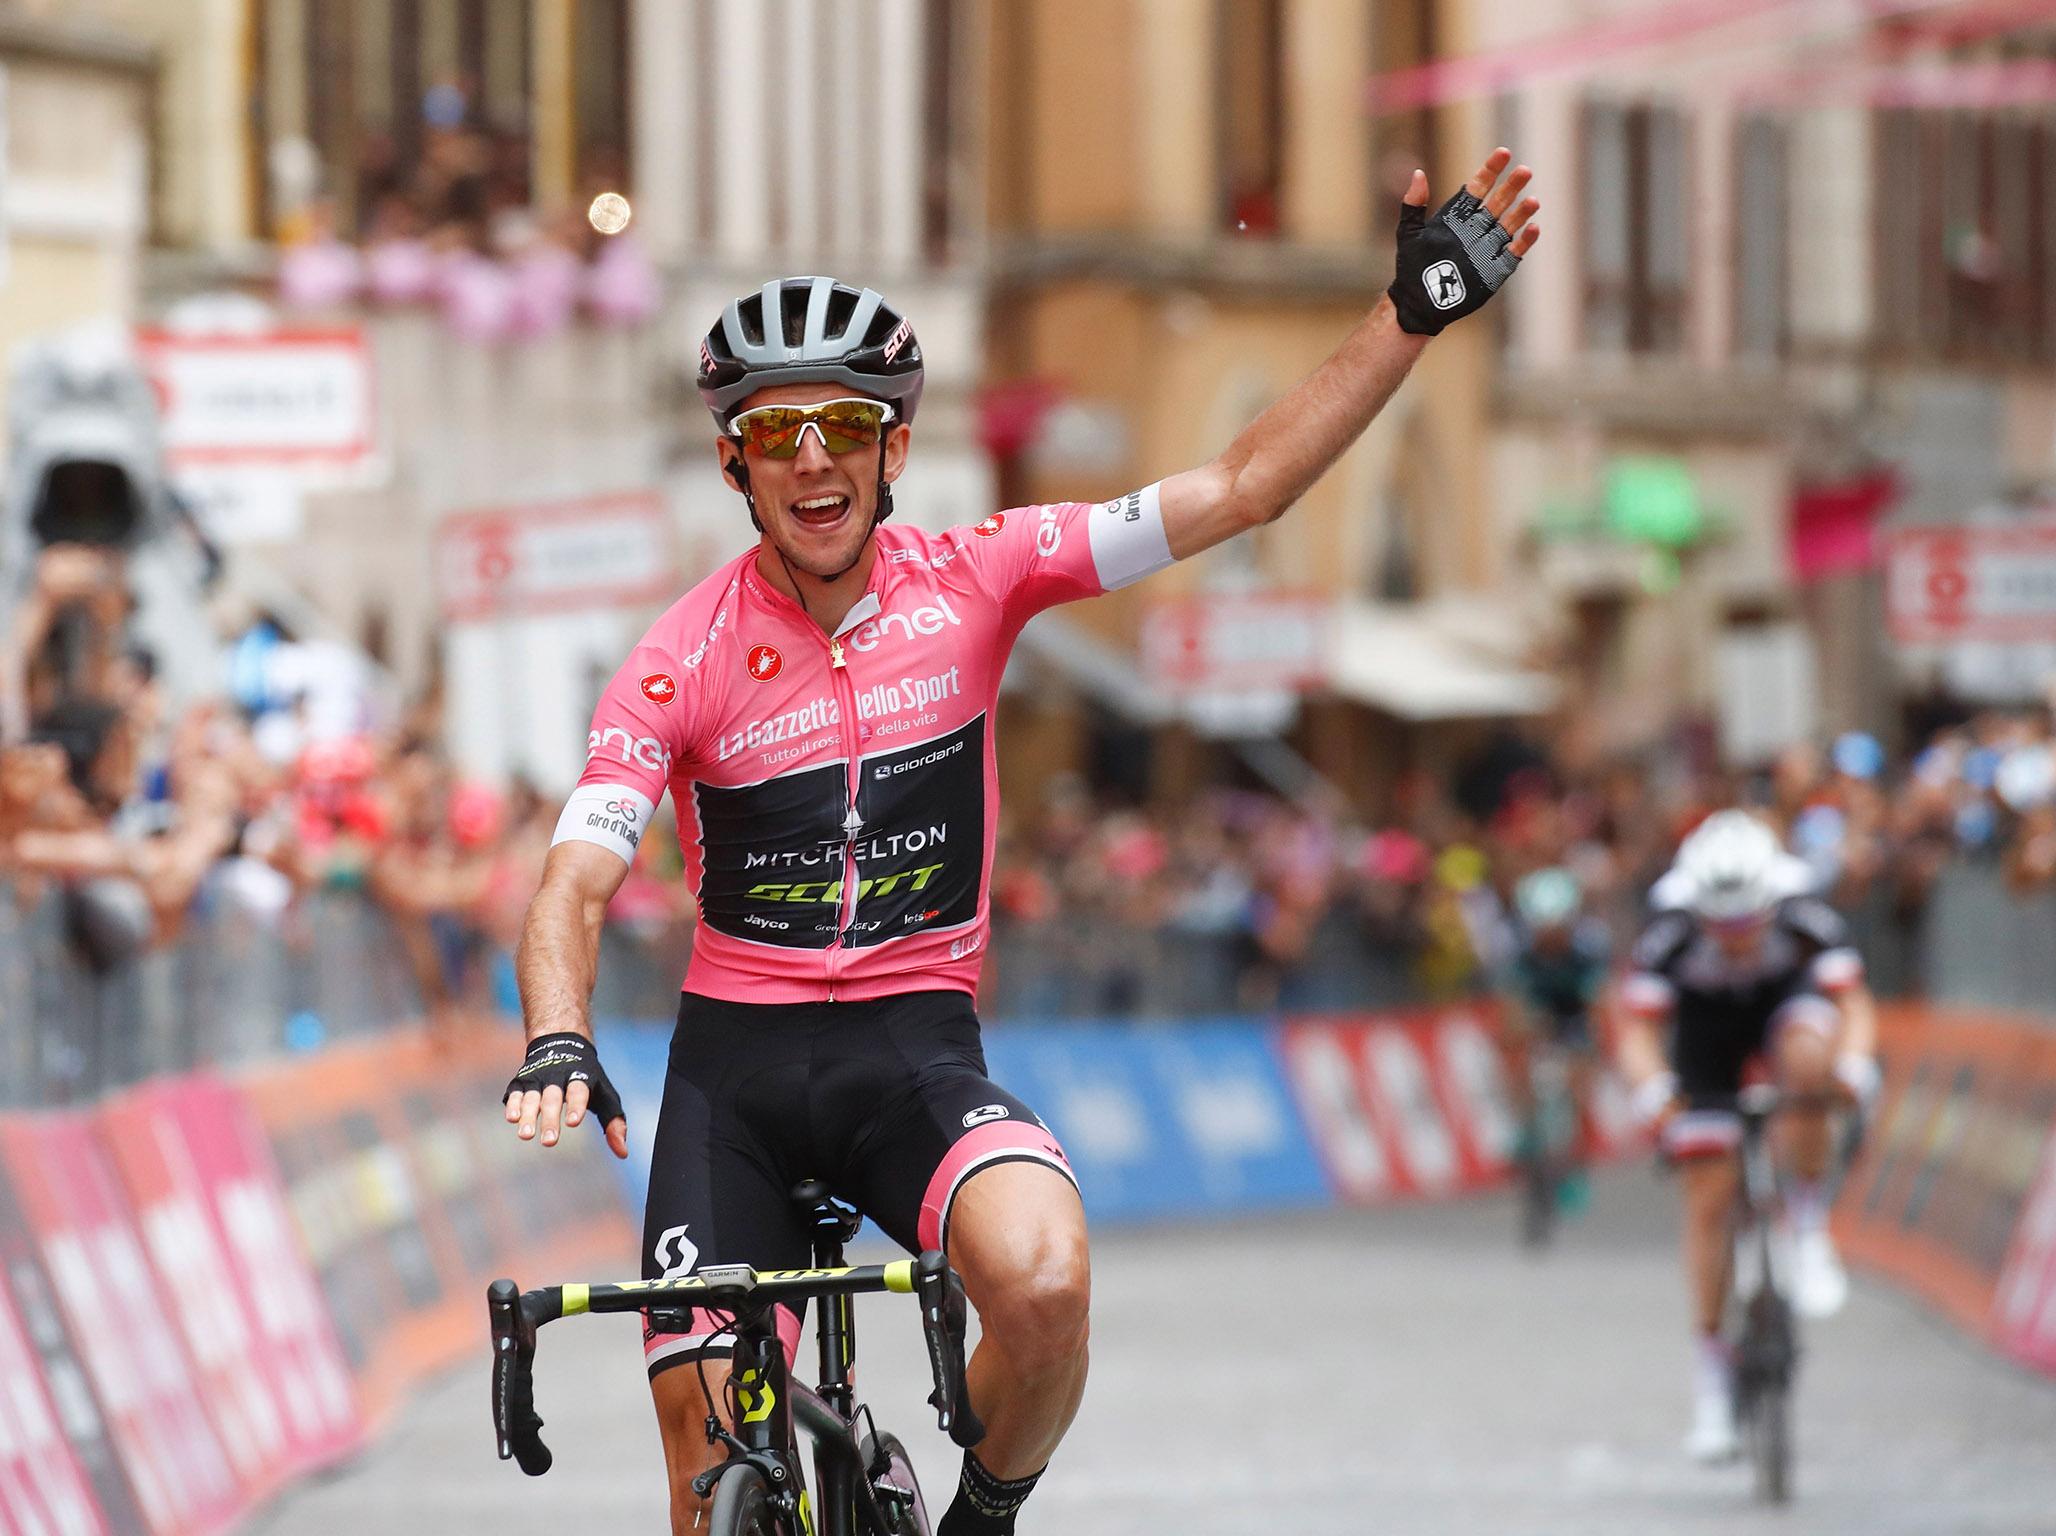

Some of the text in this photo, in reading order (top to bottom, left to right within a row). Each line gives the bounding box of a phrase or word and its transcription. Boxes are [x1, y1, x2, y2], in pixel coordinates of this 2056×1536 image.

[851, 594, 961, 652] enel
[900, 665, 960, 712] Sport
[760, 713, 938, 765] Tutto il rosa della vita
[587, 813, 610, 829] Giro
[744, 823, 946, 869] MITCHELTON
[743, 863, 944, 903] SCOTT
[744, 914, 789, 930] Jayco
[707, 1270, 739, 1278] GARMIN
